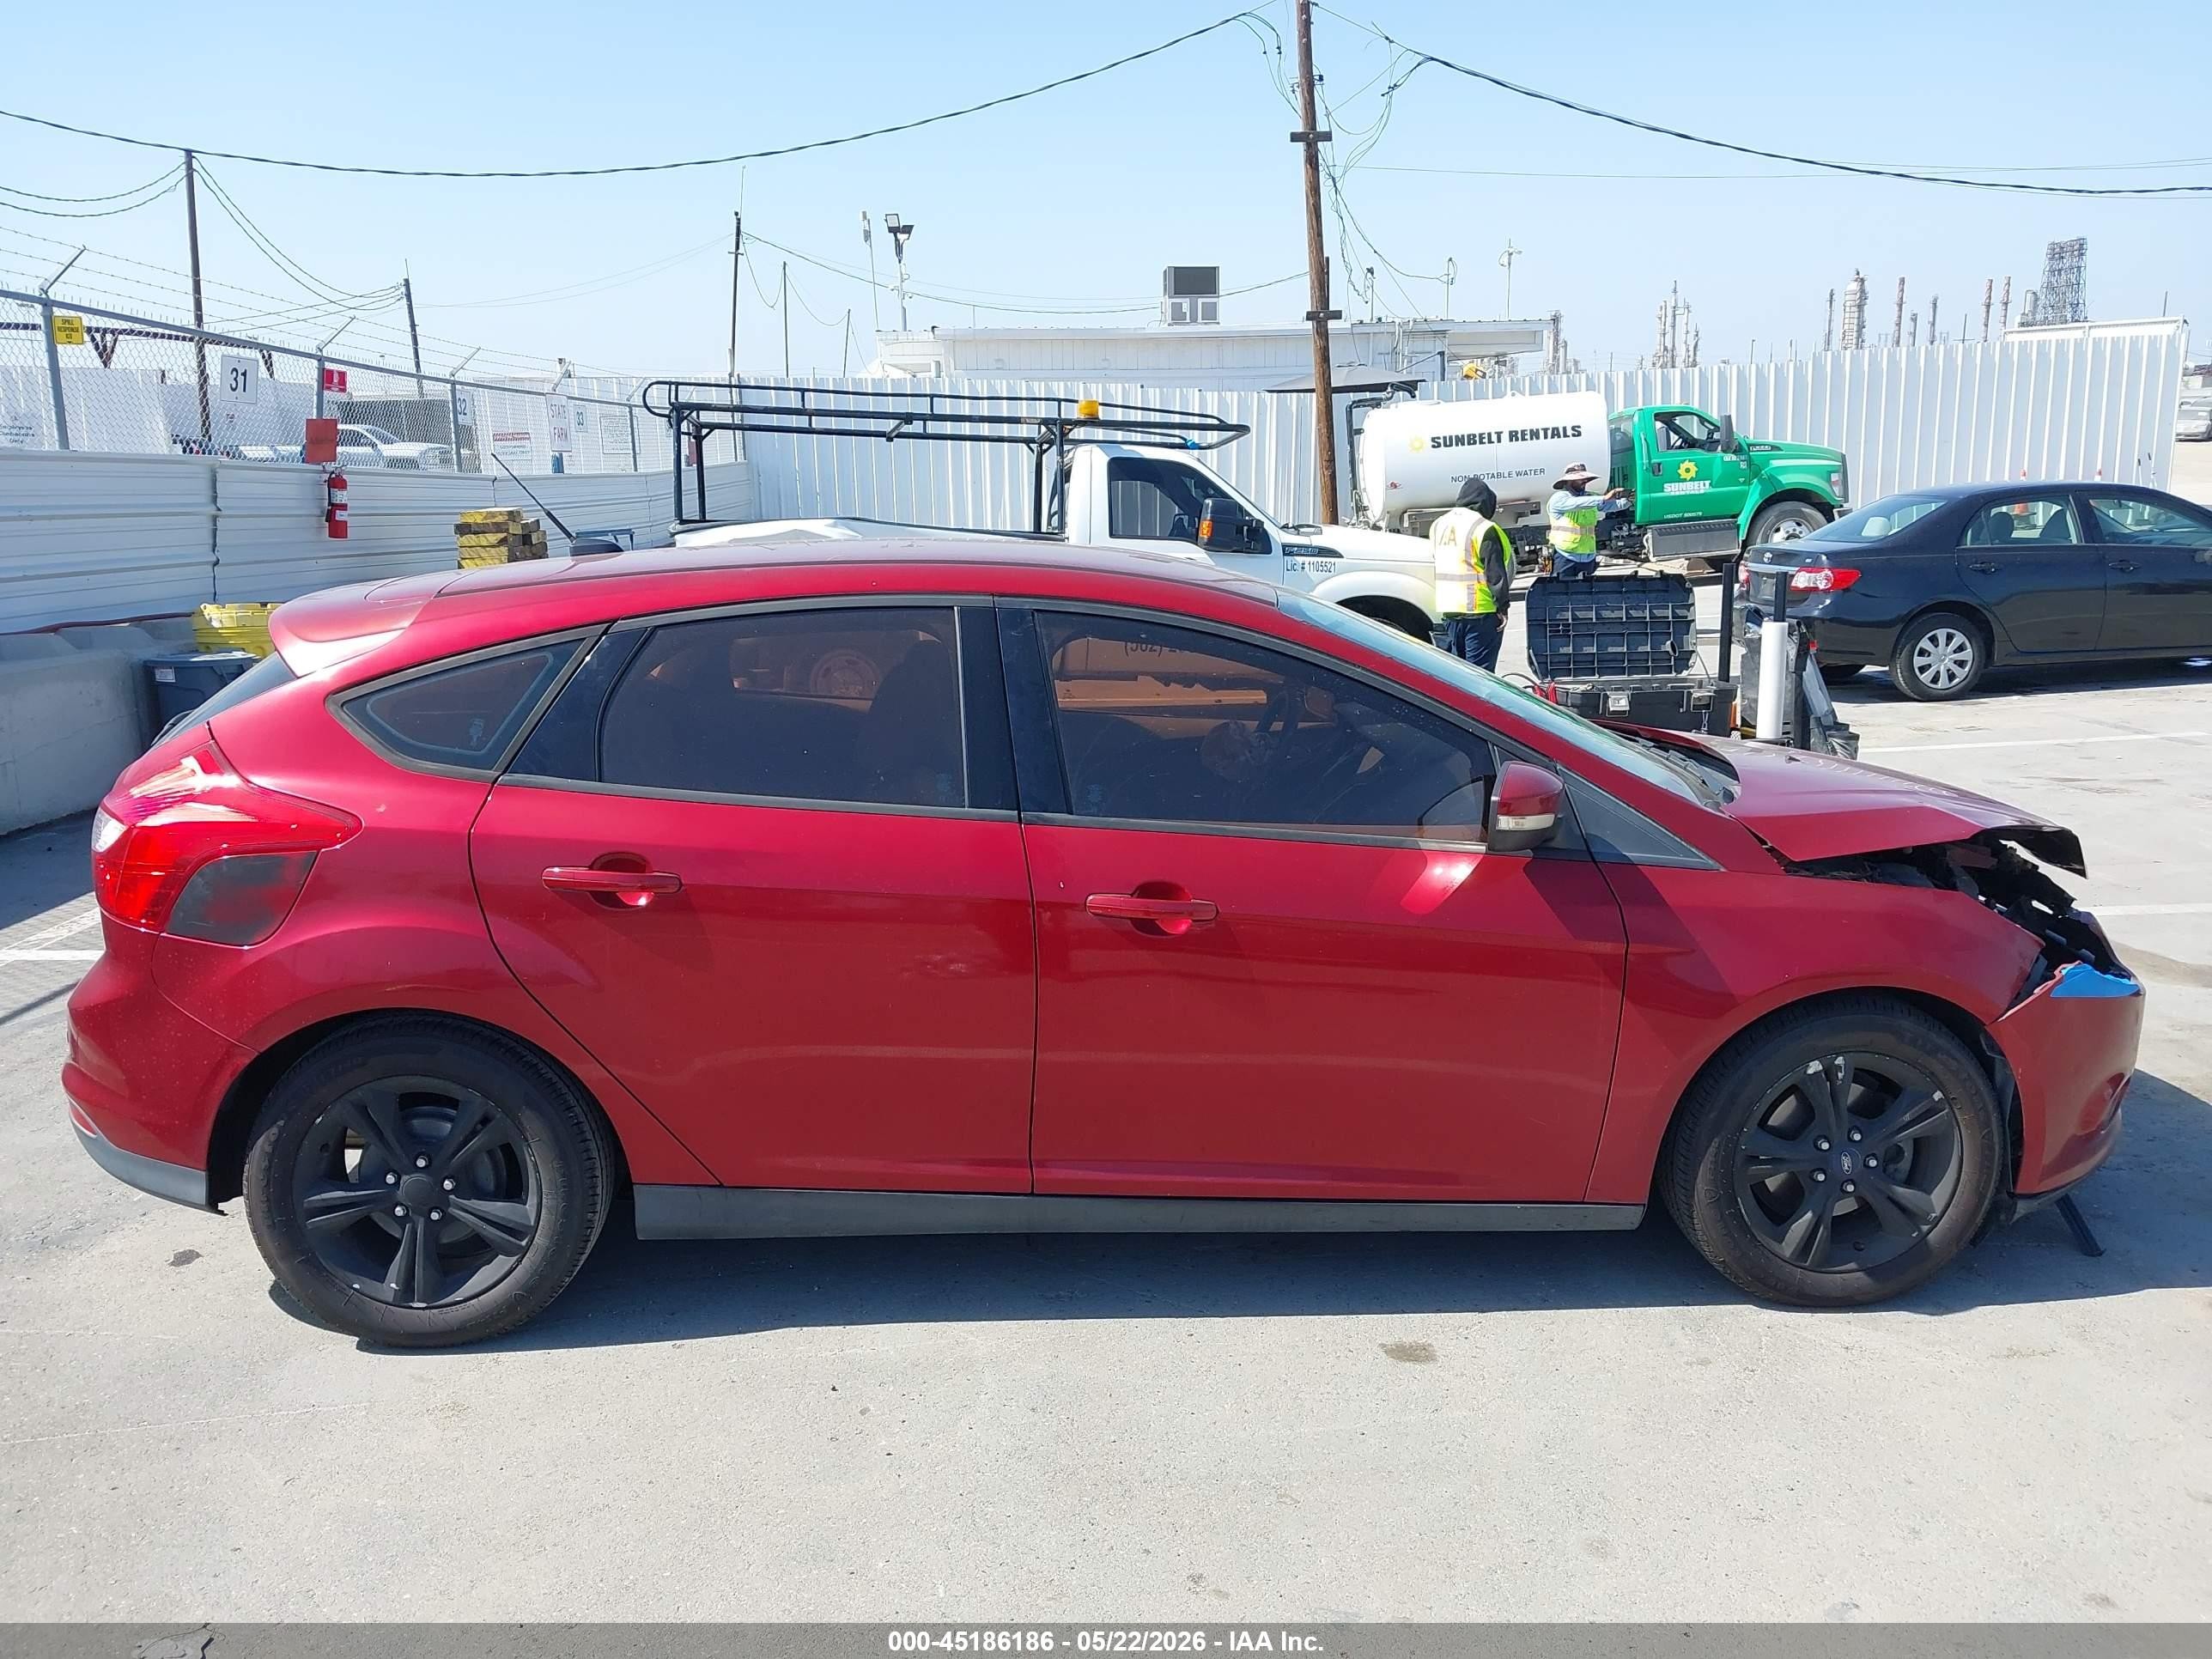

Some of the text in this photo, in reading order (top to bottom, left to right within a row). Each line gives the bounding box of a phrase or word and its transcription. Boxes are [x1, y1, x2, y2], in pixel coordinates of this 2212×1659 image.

[229, 367, 247, 392] 31
[457, 397, 467, 416] 32
[550, 404, 567, 420] STATE
[576, 410, 584, 427] 33
[553, 426, 568, 442] FARM
[1431, 425, 1582, 448] SUNBELT RENTALS
[1515, 468, 1546, 477] WATER
[1663, 480, 1711, 492] SUNBELT
[1285, 560, 1336, 574] Lic. # 1105521
